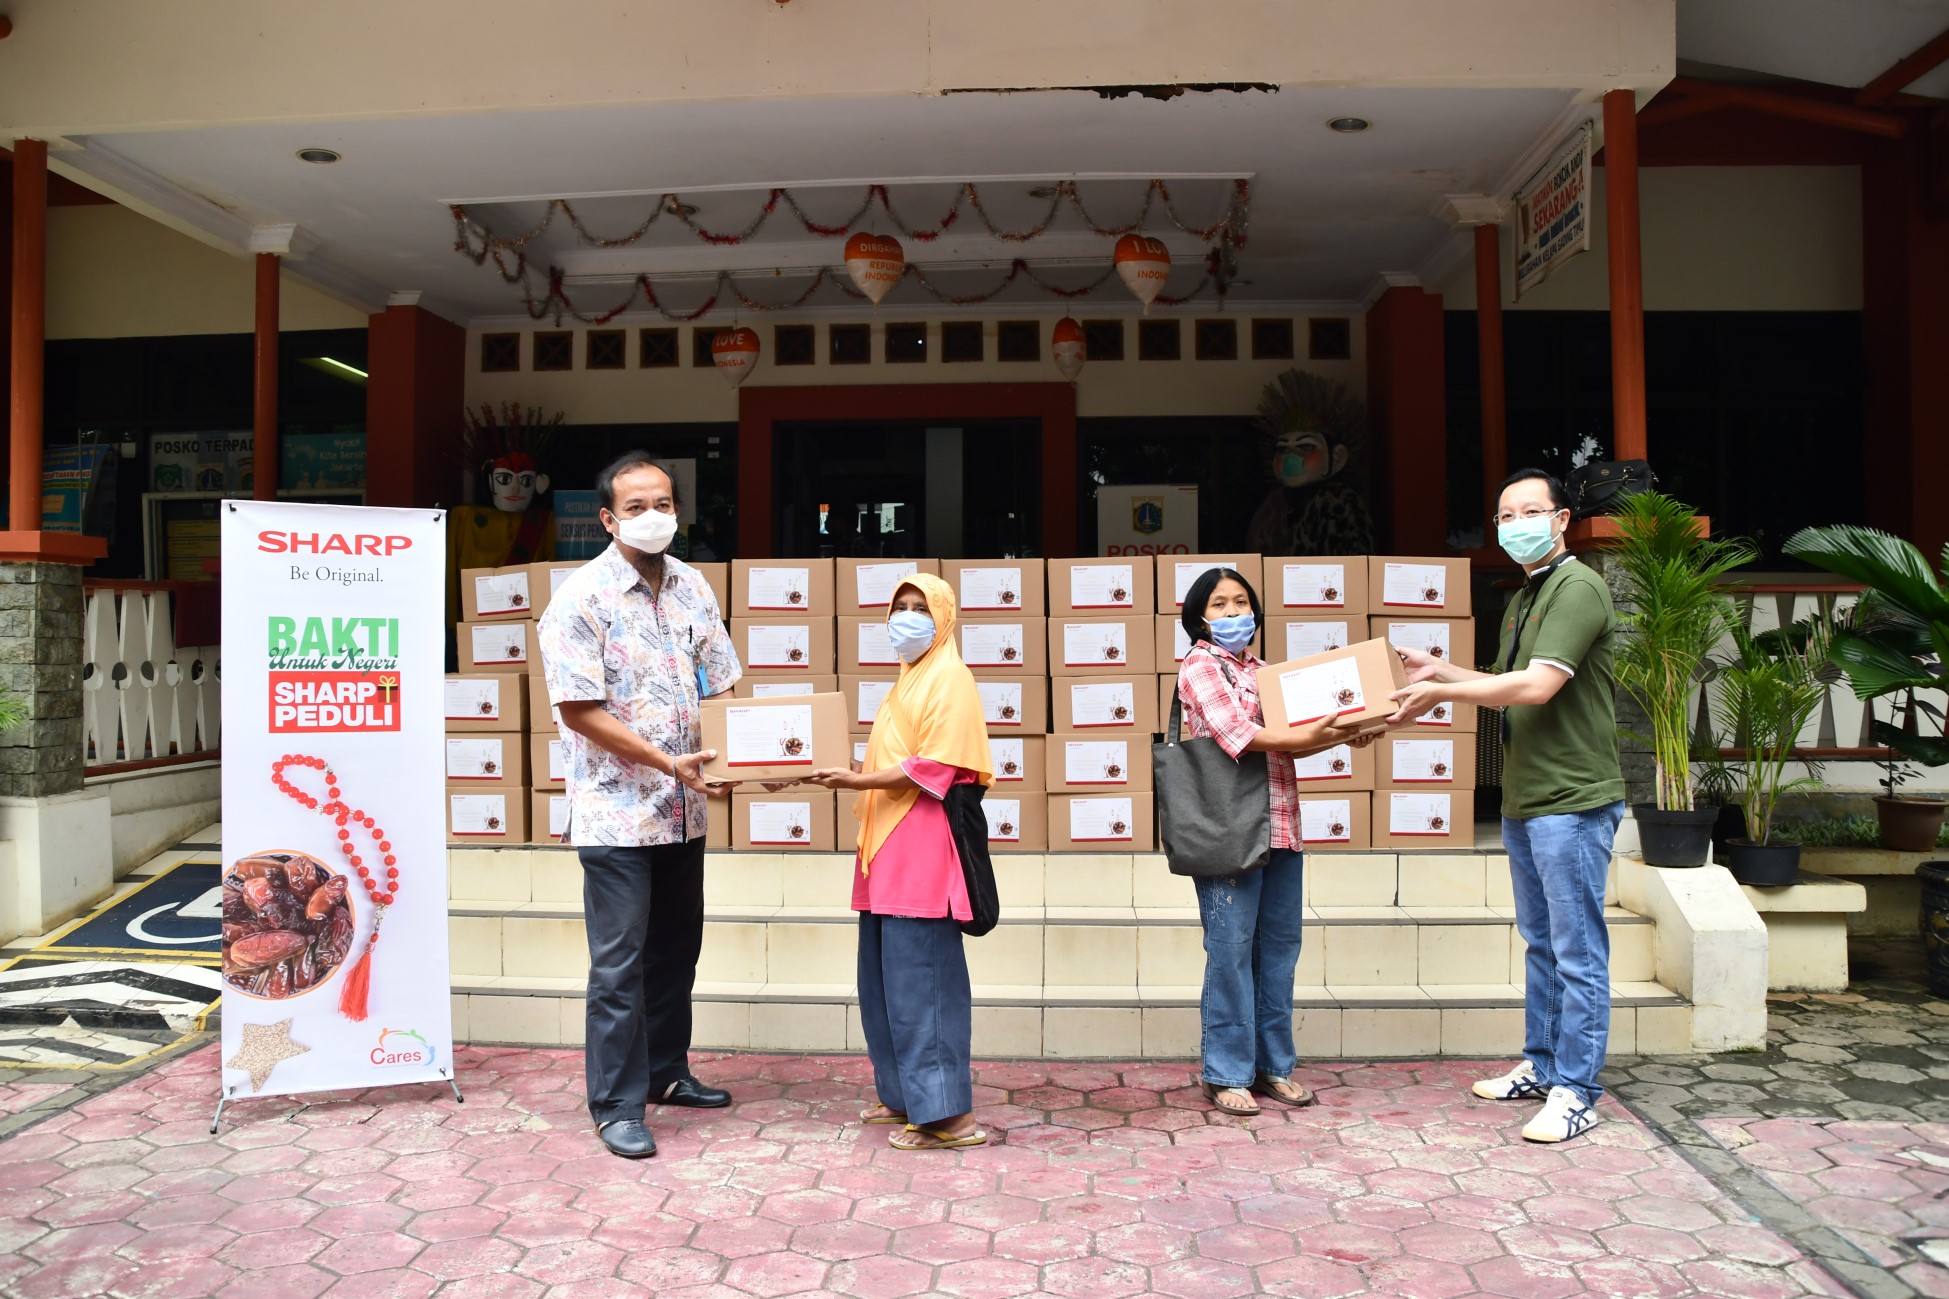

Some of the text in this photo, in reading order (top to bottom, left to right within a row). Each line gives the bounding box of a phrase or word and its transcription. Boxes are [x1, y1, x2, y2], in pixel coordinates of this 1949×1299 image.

[154, 440, 200, 454] POSKO
[257, 530, 413, 556] SHARP
[290, 565, 384, 586] Be Original.
[268, 616, 399, 657] BAKTI
[268, 647, 398, 676] Untuk Negeri
[274, 681, 377, 704] SHARP
[275, 704, 393, 727] PEDULI
[370, 1047, 421, 1065] Cares
